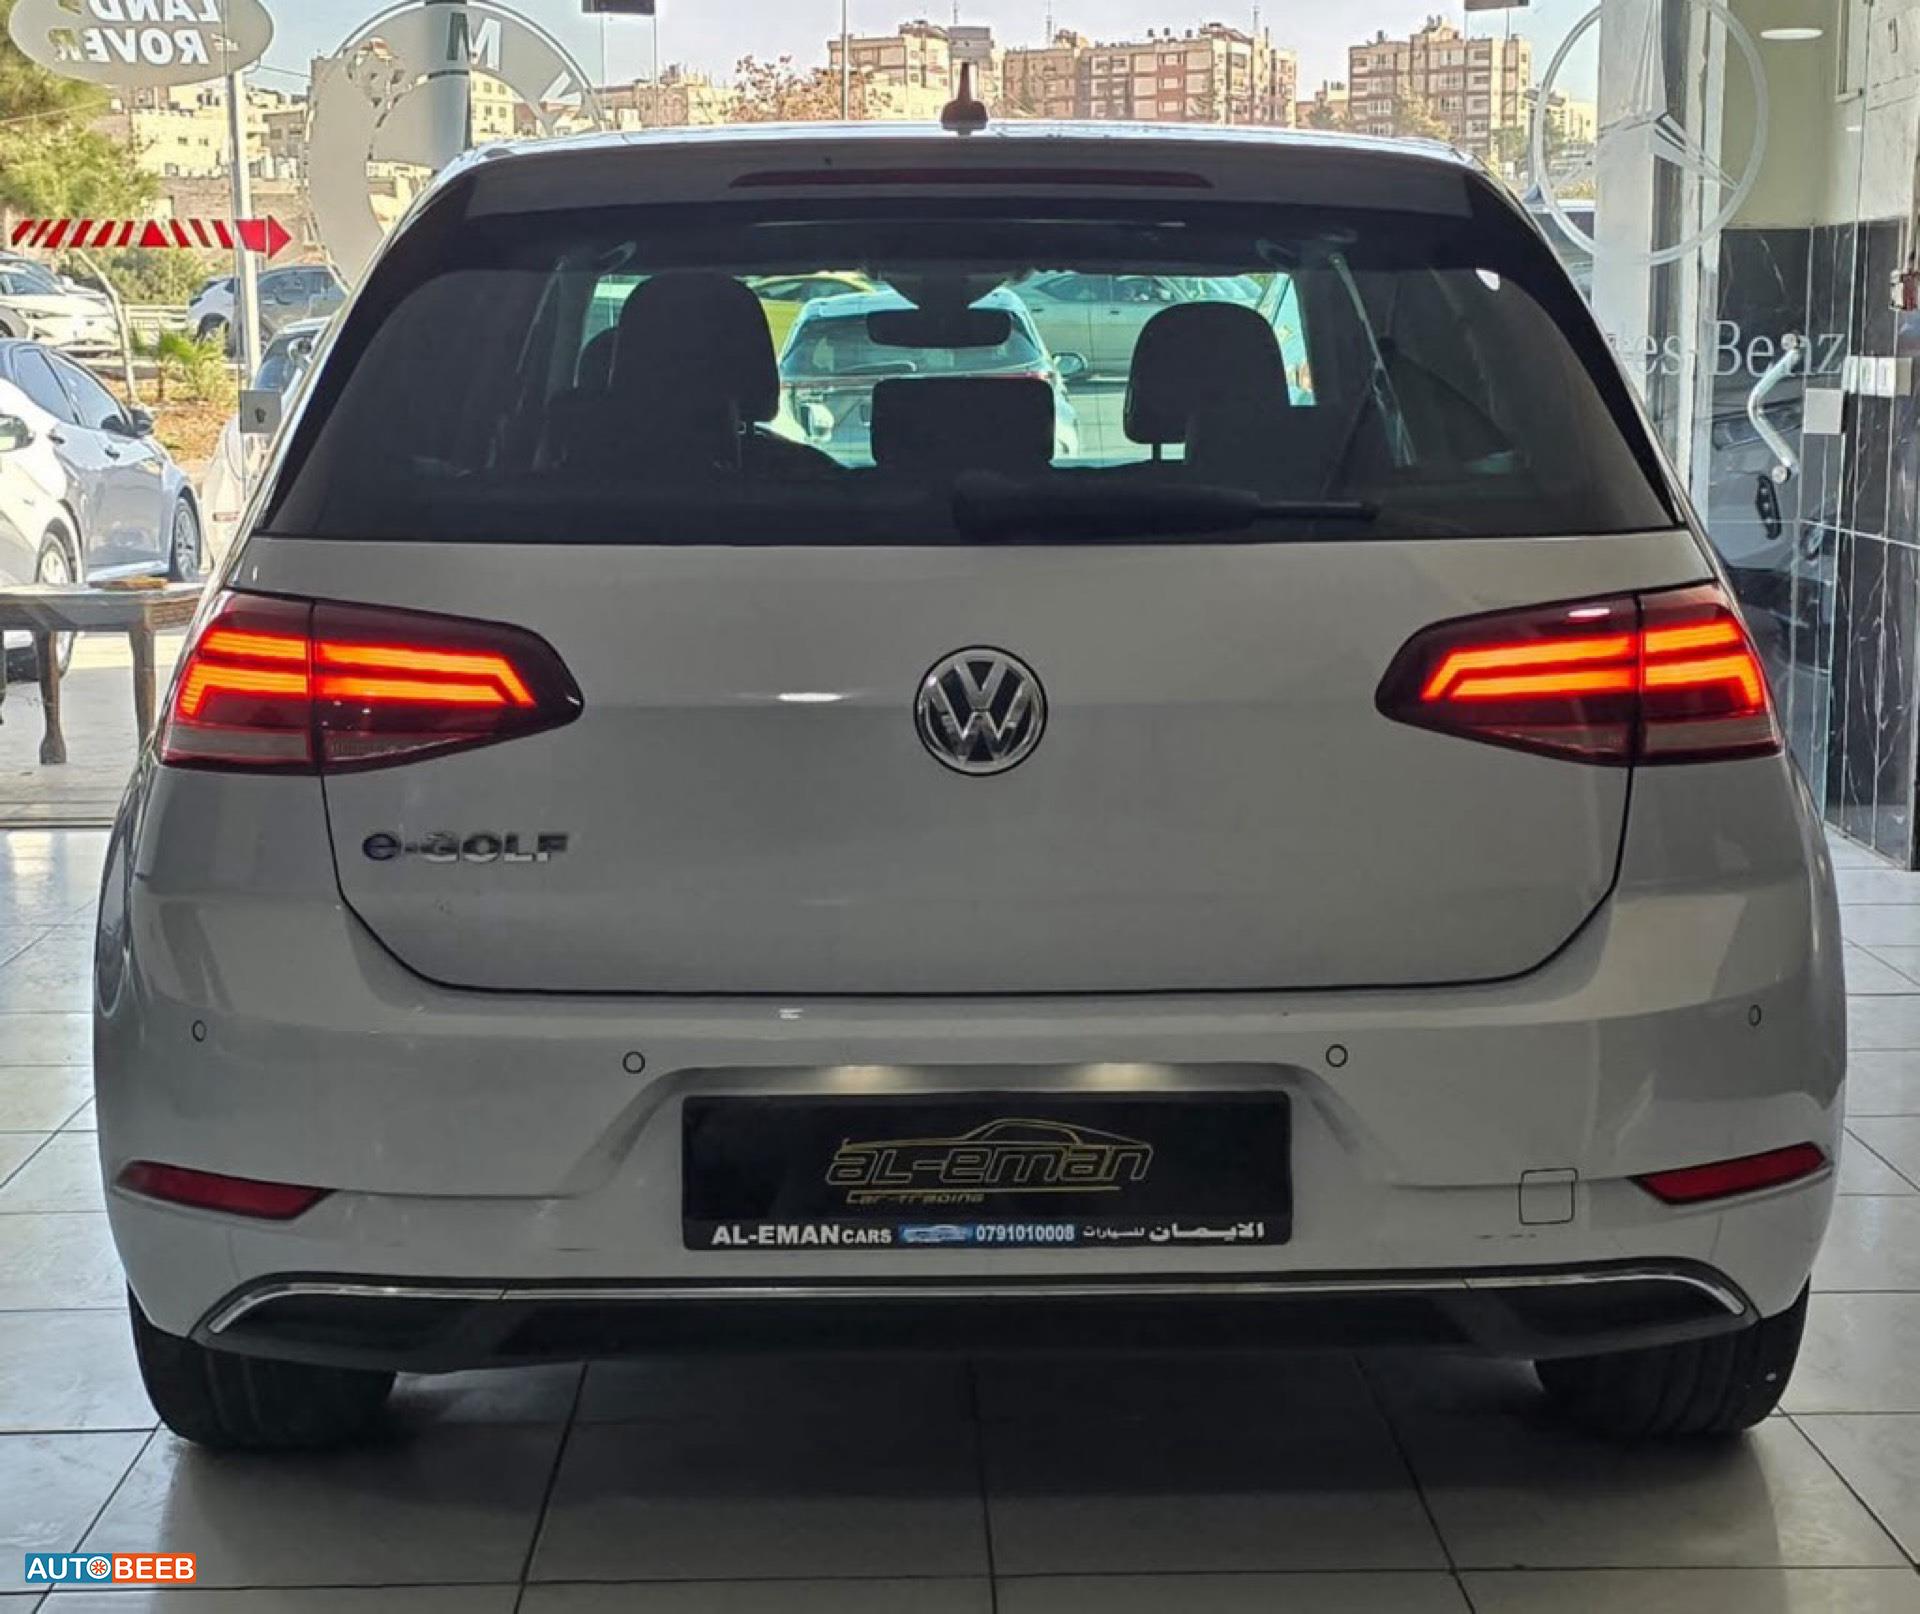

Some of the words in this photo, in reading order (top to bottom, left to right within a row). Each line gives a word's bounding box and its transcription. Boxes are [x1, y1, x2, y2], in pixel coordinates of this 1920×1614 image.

[711, 1225, 839, 1245] AL-EMAN
[841, 1229, 892, 1244] CARS
[976, 1223, 1075, 1241] 0791010008
